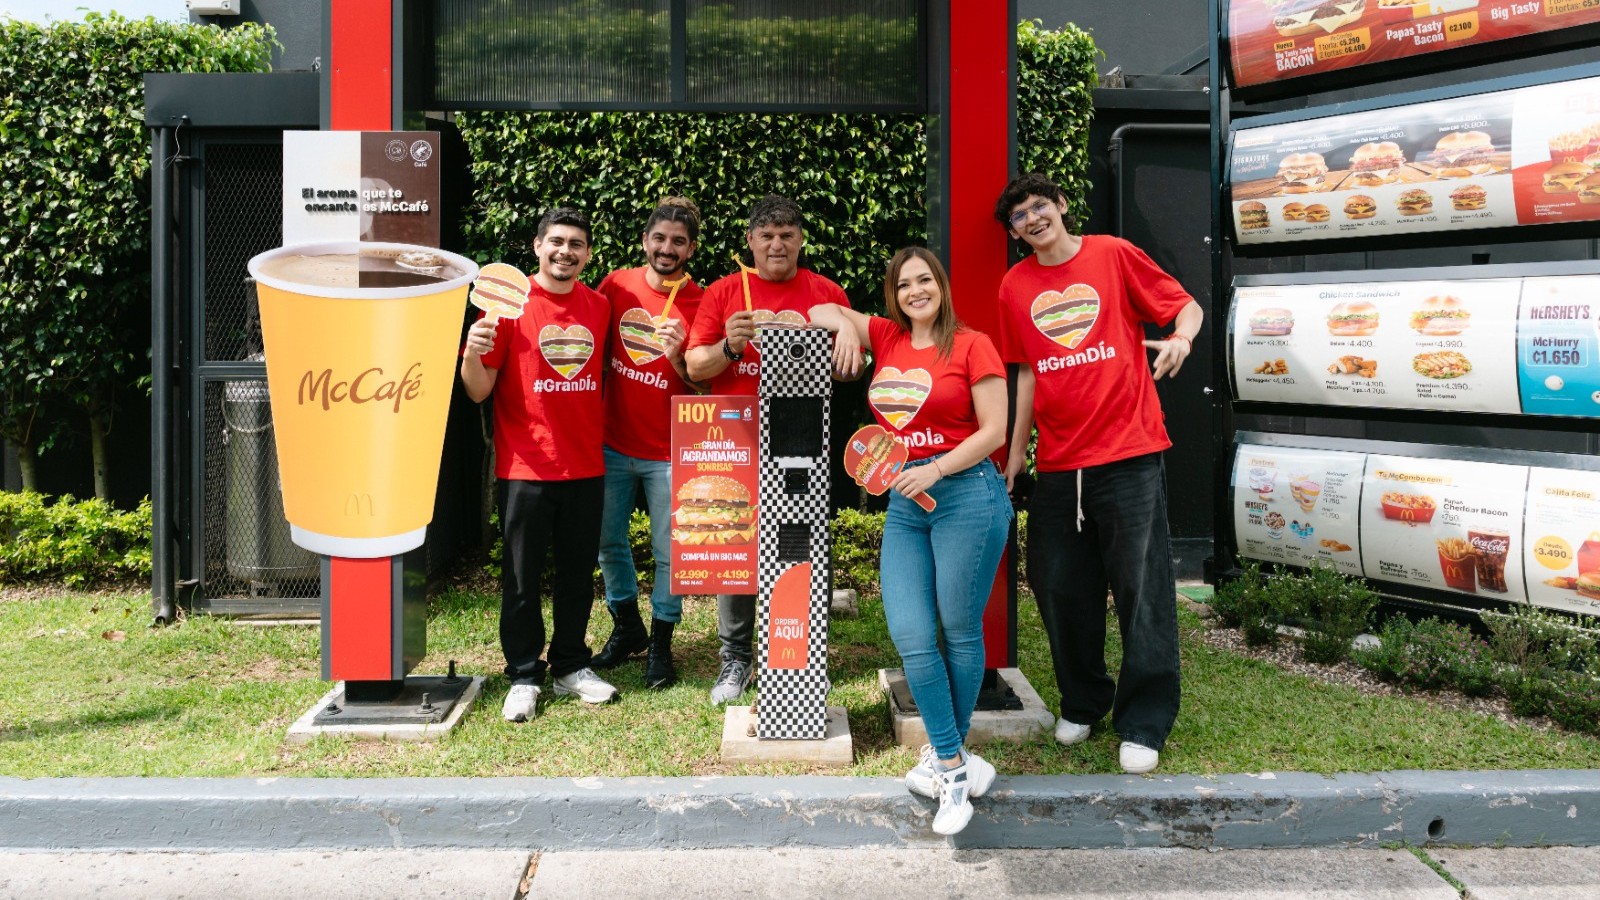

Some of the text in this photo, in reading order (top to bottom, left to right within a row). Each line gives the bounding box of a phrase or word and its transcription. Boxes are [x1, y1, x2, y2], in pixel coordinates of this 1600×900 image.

[1491, 2, 1540, 20] Big Tasty
[1386, 21, 1443, 42] Papas Tasty
[1414, 32, 1444, 46] Bacon
[1276, 54, 1314, 72] BACON
[302, 188, 402, 200] El aroma que te
[304, 200, 429, 212] encanta es McCafé
[1319, 291, 1354, 299] Chicken
[1532, 336, 1580, 350] McFlurry
[1532, 350, 1580, 366] ¢1.650
[298, 362, 424, 414] McCafé
[678, 402, 716, 424] HOY
[702, 441, 722, 450] GRAN
[723, 438, 736, 450] DÍA
[682, 450, 748, 462] AGRANDAMOS
[696, 462, 734, 472] SONRISAS
[1388, 472, 1426, 482] McCombo
[1480, 508, 1508, 517] Bacon
[681, 550, 748, 561] COMPRÁ UN BIG MAC
[774, 622, 804, 640] AQUÍ
